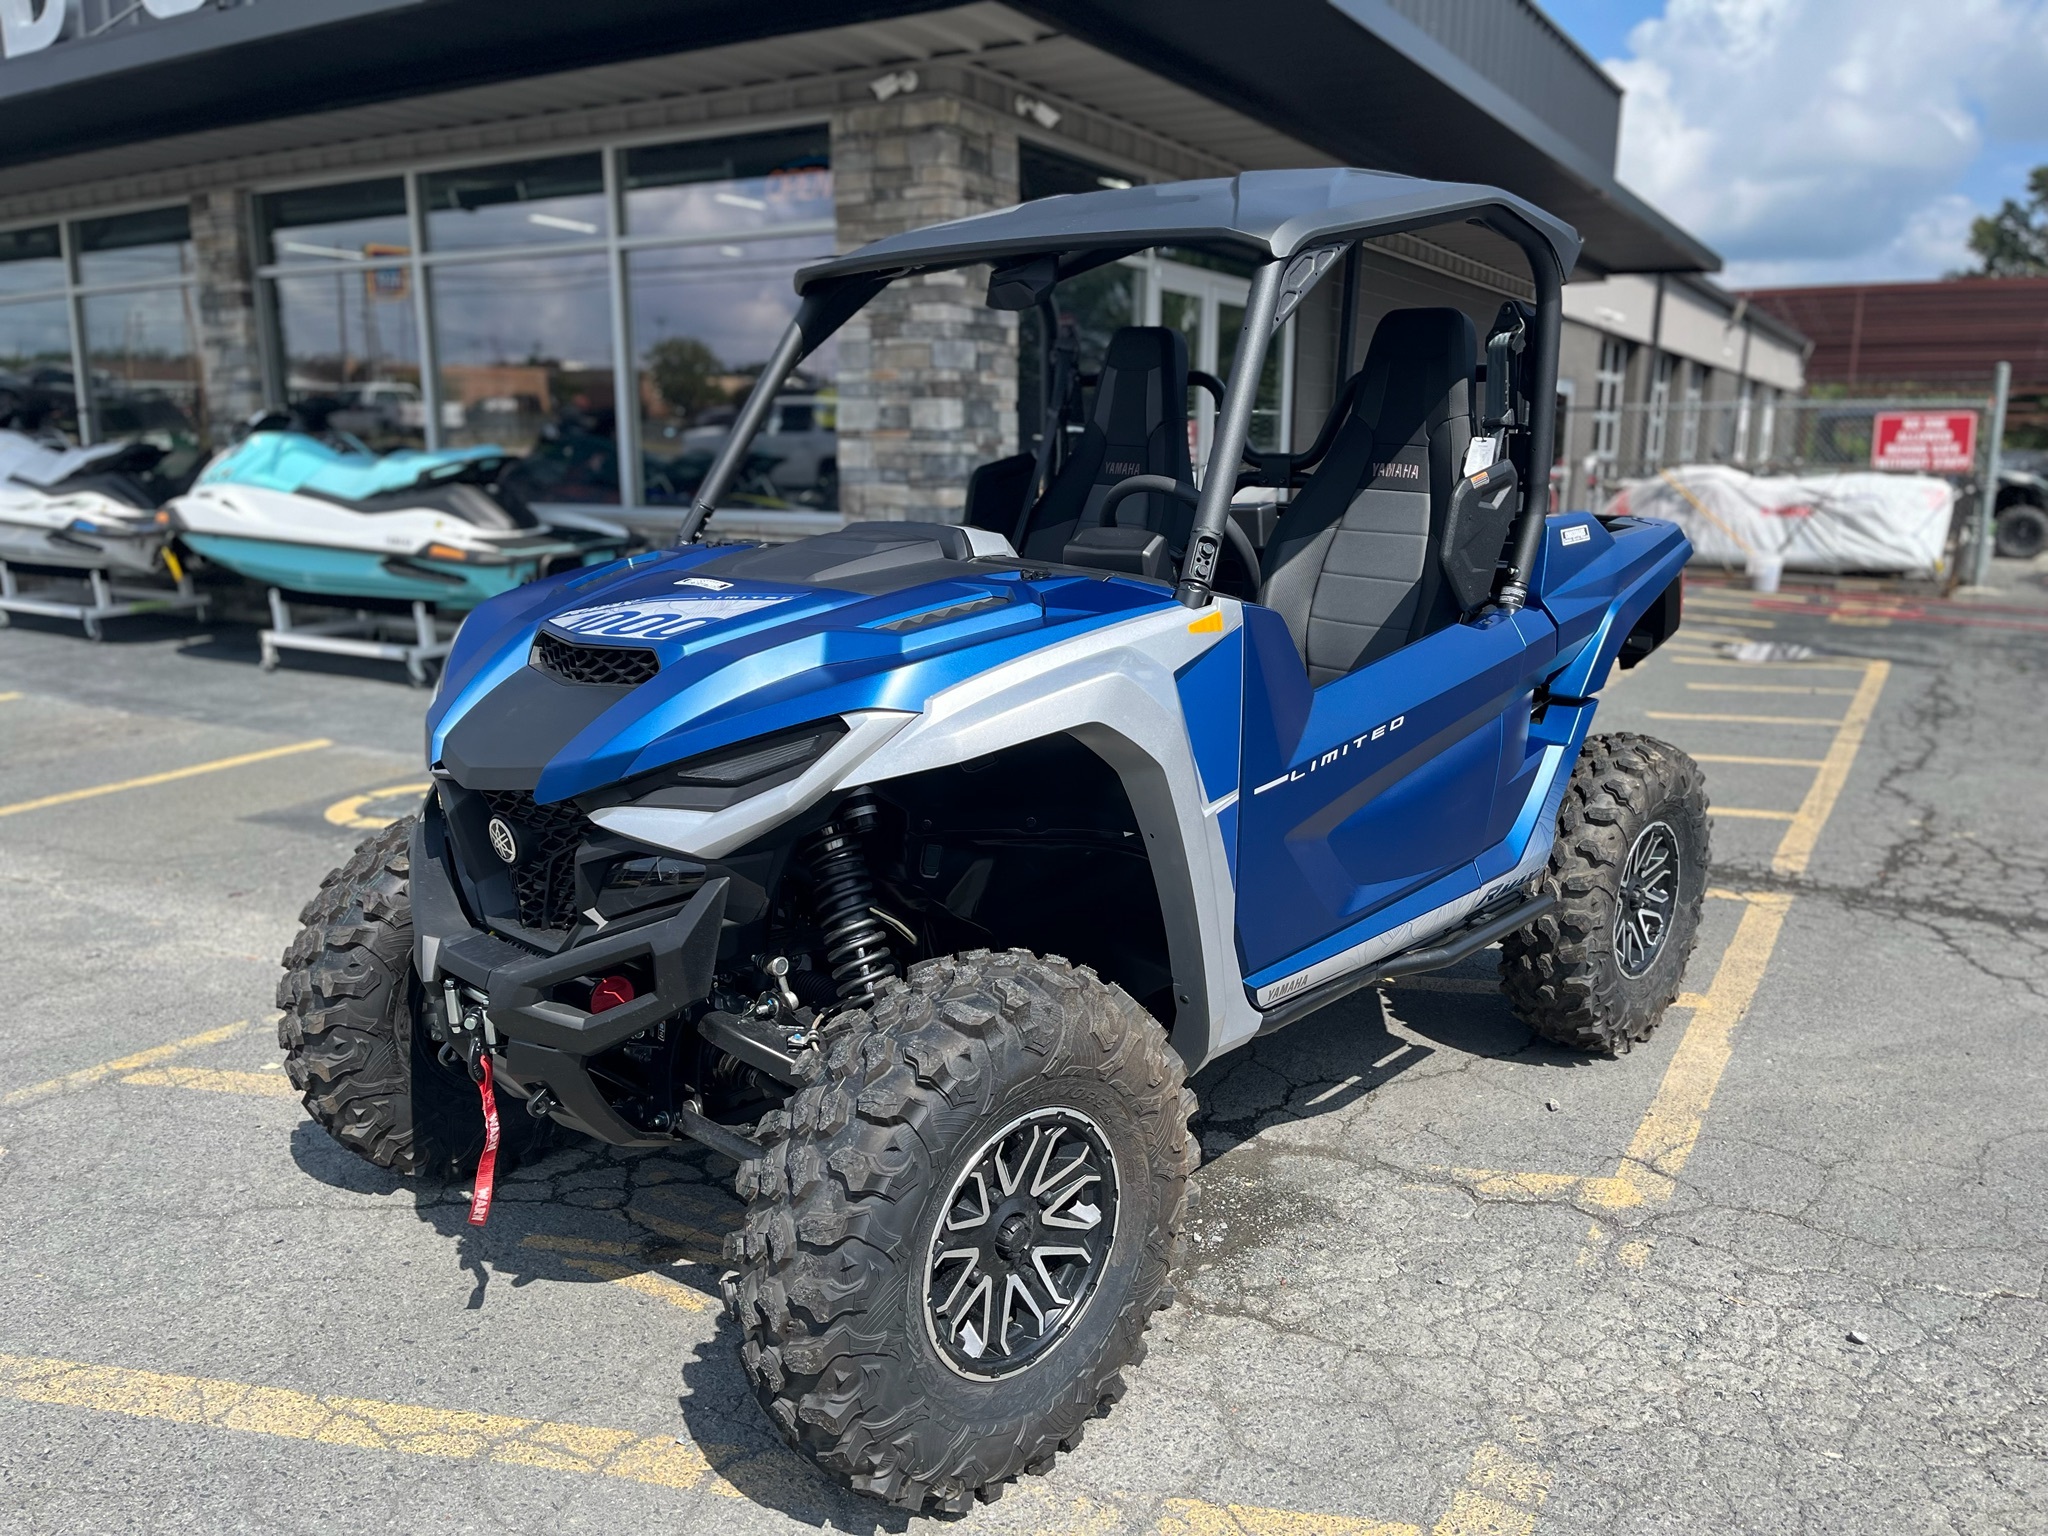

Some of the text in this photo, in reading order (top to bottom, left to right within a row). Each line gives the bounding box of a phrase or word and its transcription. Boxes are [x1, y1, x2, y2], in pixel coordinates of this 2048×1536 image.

[1105, 461, 1141, 476] YAMAHA
[1372, 462, 1420, 480] YAMAHA
[1290, 715, 1405, 782] LIMITED
[1268, 974, 1309, 1001] YAMAHA
[485, 1111, 500, 1152] WARN
[470, 1186, 491, 1222] WARN
